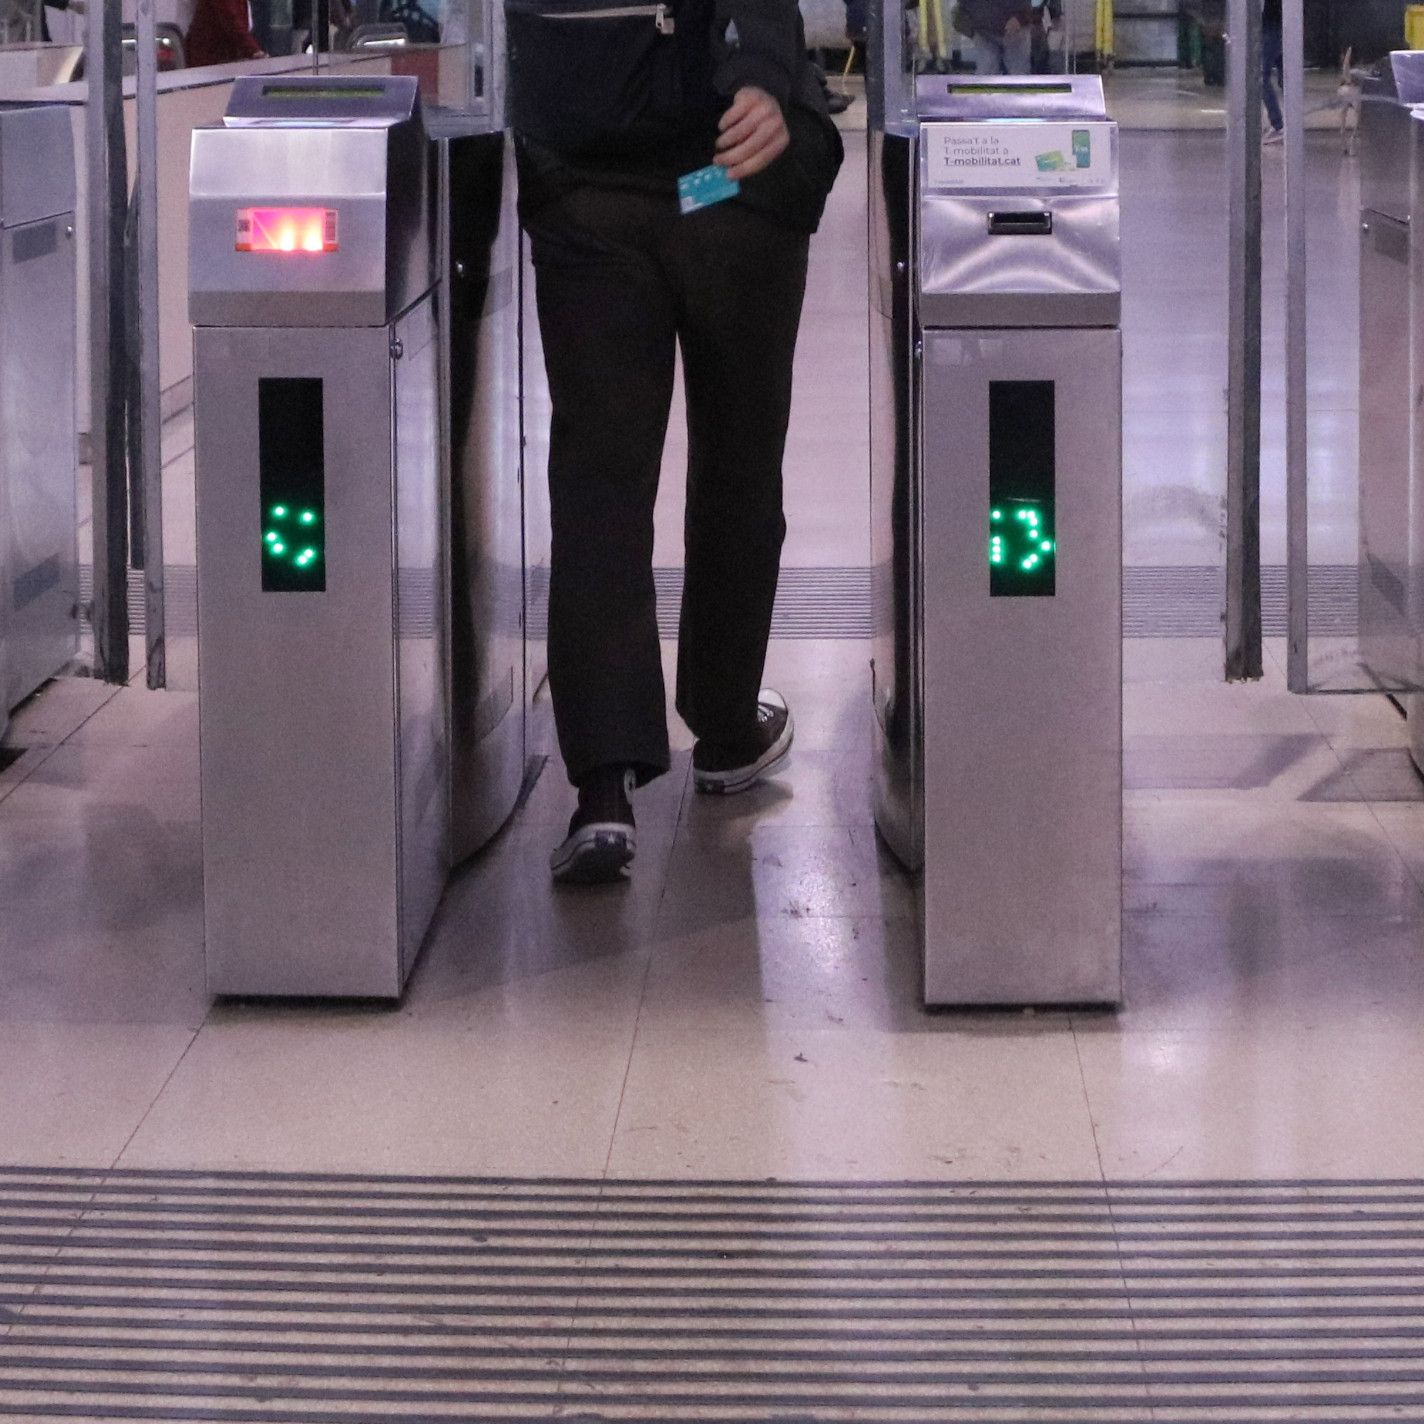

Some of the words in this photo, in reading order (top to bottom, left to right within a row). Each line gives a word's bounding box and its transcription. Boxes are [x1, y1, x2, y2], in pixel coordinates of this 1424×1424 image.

[944, 136, 979, 146] Passa't
[981, 138, 988, 146] a
[990, 136, 1000, 146] la
[944, 147, 1000, 156] T-mobilitat
[944, 157, 1022, 168] T-mobilitat.cat
